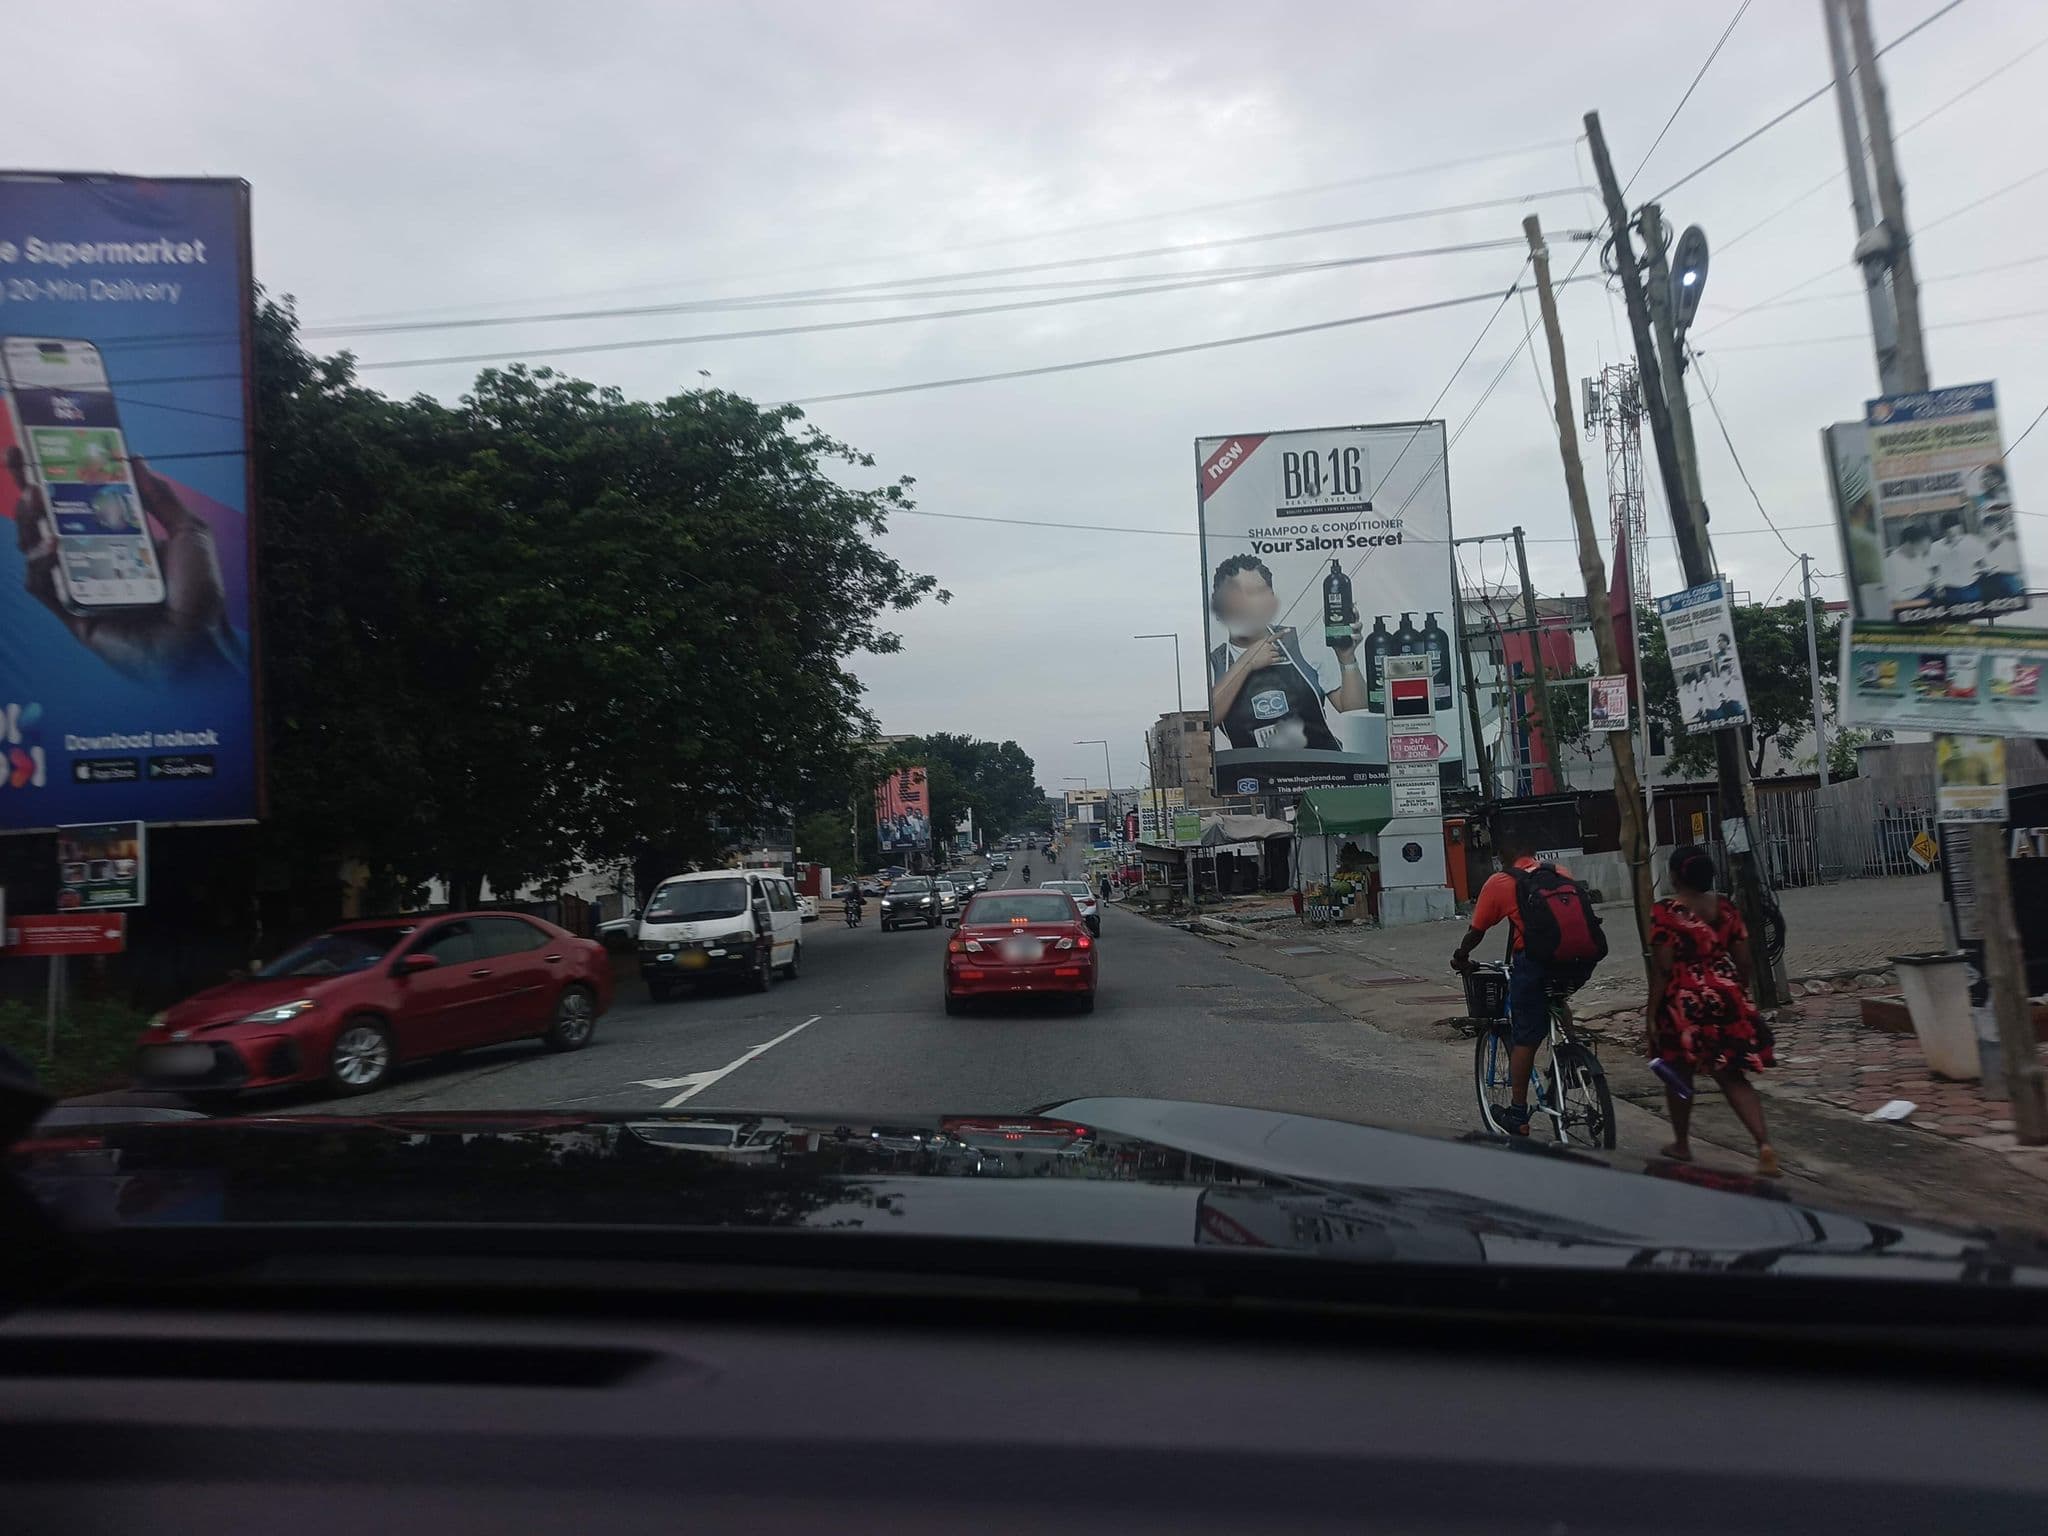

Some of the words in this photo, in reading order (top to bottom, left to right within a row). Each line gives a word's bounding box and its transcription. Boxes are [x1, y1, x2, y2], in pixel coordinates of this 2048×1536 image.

[24, 235, 207, 269] Supermarket
[91, 278, 182, 304] Delivery
[1207, 441, 1244, 480] new
[1248, 525, 1308, 538] SHAMPOO
[1310, 524, 1320, 533] &
[1323, 519, 1403, 532] CONDITIONER
[1250, 539, 1293, 554] Your
[1295, 536, 1344, 552] Salon
[1346, 532, 1403, 548] Secret
[1256, 696, 1284, 713] GC
[65, 732, 152, 751] Download
[1404, 744, 1431, 752] DIGITAL
[1277, 775, 1346, 784] www.thegcbrand.com
